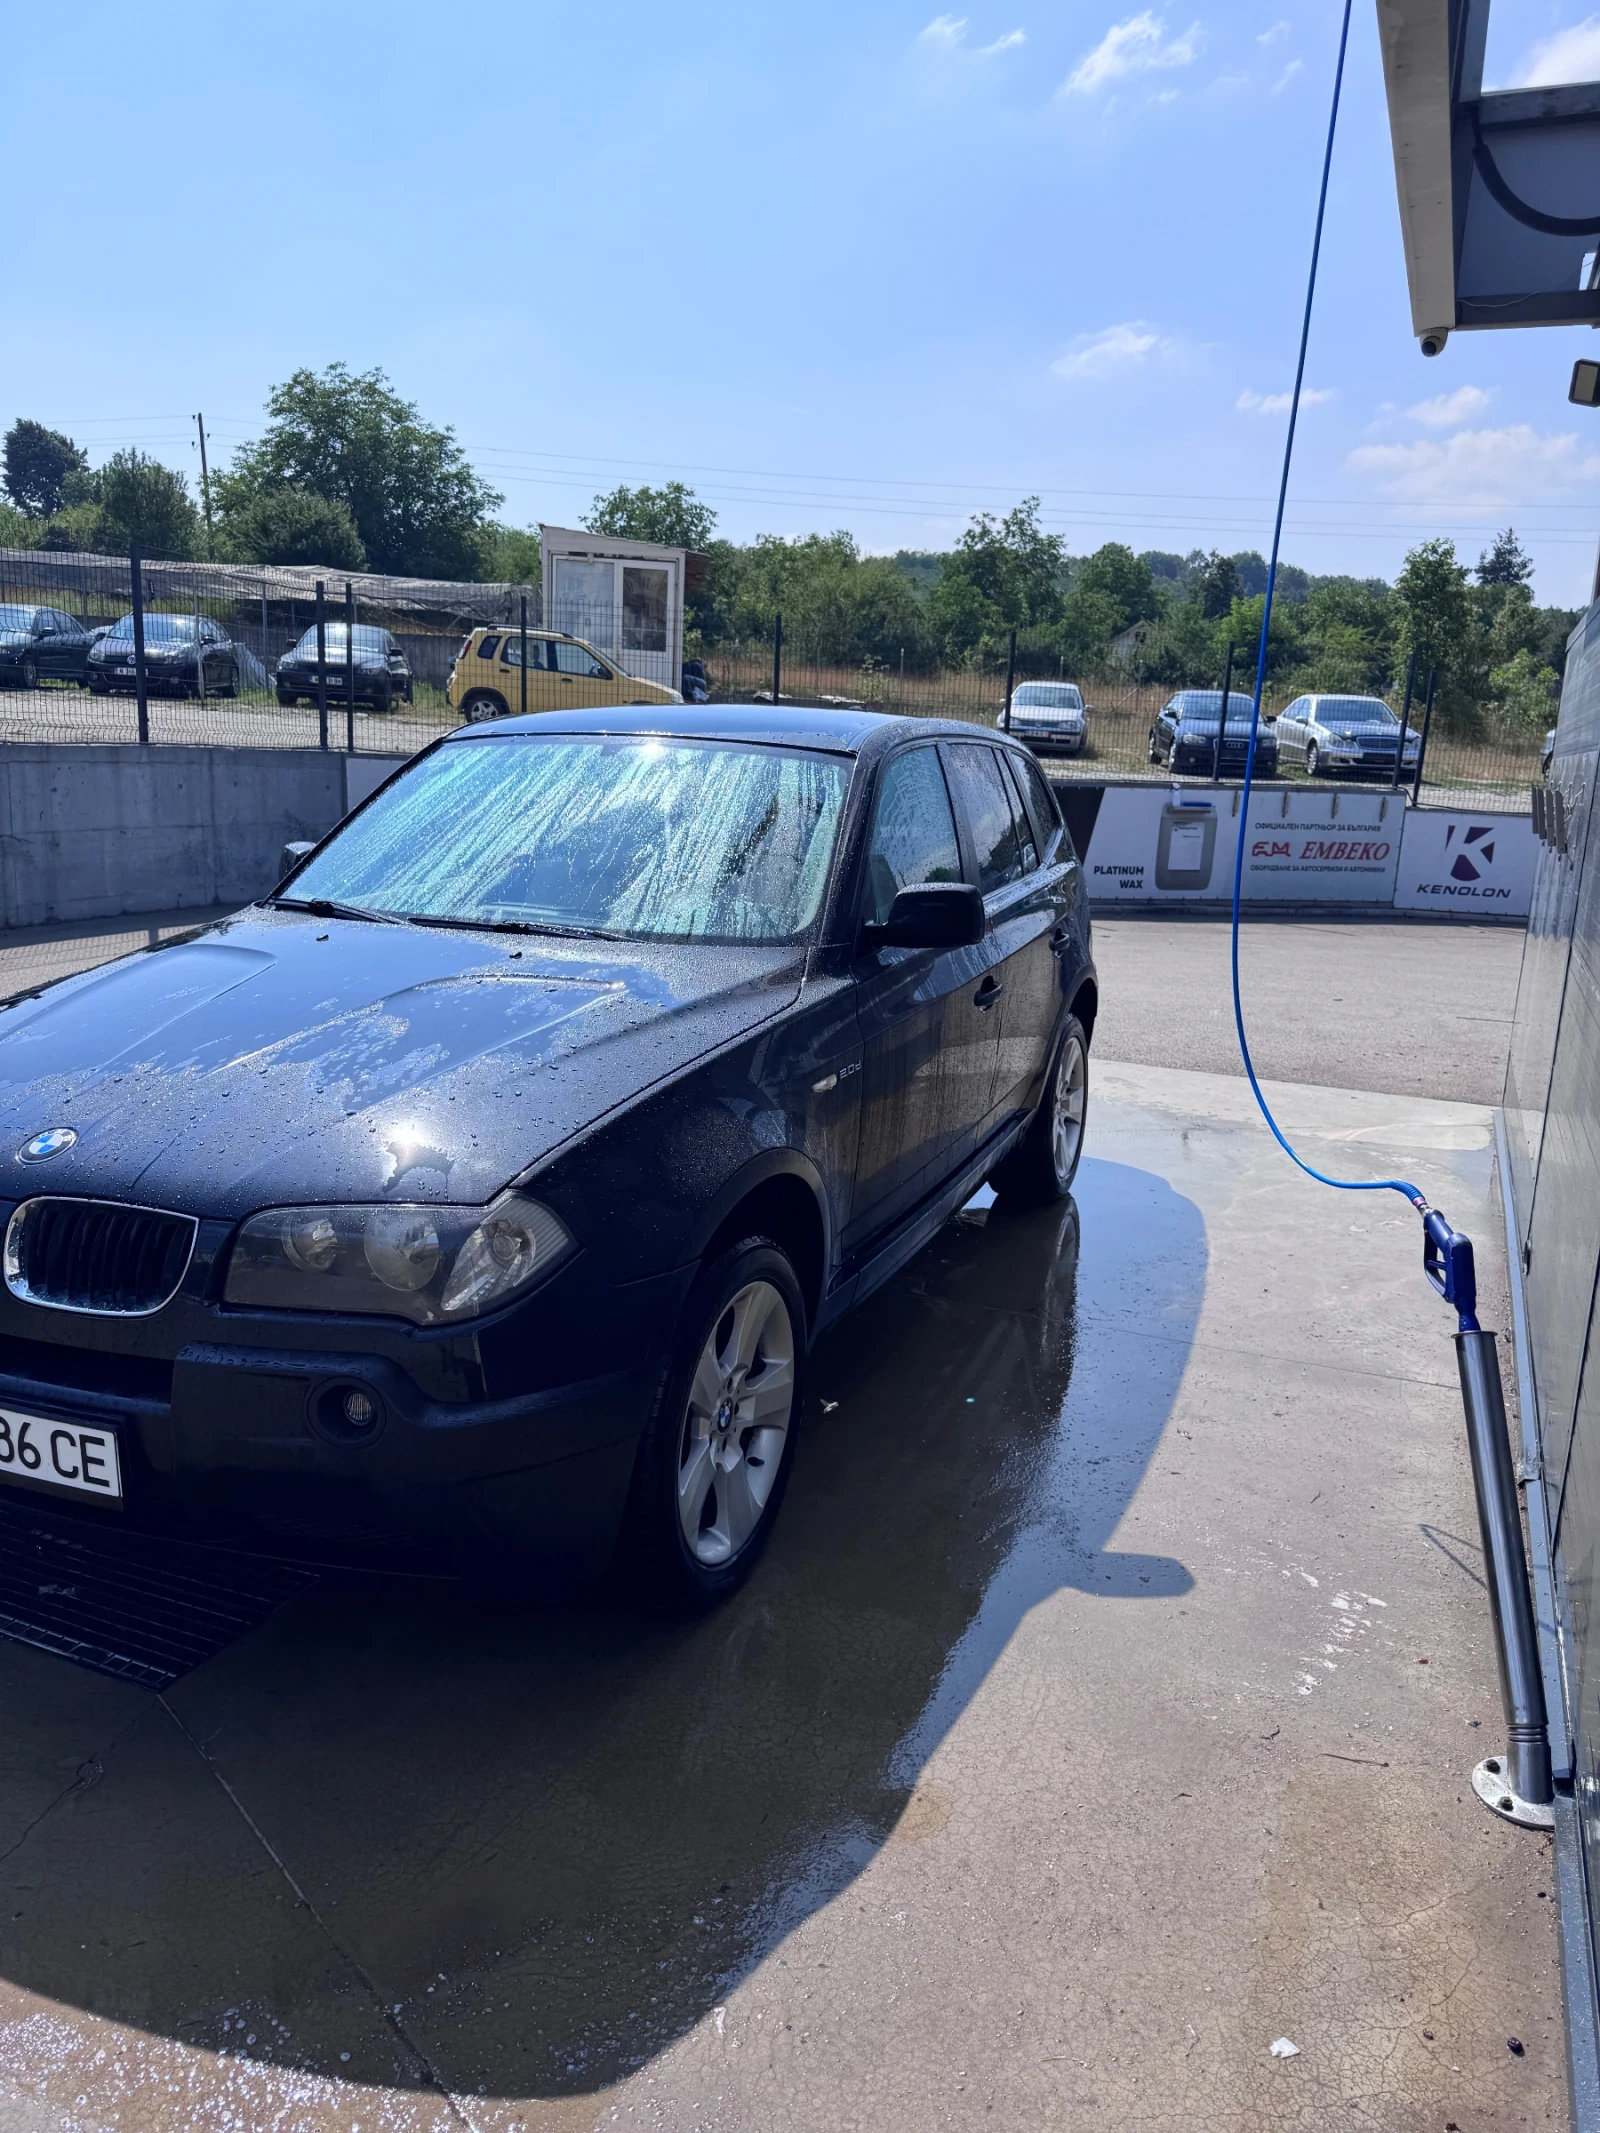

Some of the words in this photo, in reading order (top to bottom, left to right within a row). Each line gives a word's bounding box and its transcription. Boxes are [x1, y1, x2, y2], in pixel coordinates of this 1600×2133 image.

[1254, 822, 1300, 831] ОФИЦИАЛЕН
[1300, 823, 1336, 832] ПАРТНЬОР
[1298, 841, 1390, 861] EMBEKO
[1093, 865, 1144, 876] PLATINUM
[1119, 879, 1143, 889] WAX
[1416, 884, 1511, 898] KENOLON
[50, 1429, 111, 1488] CE
